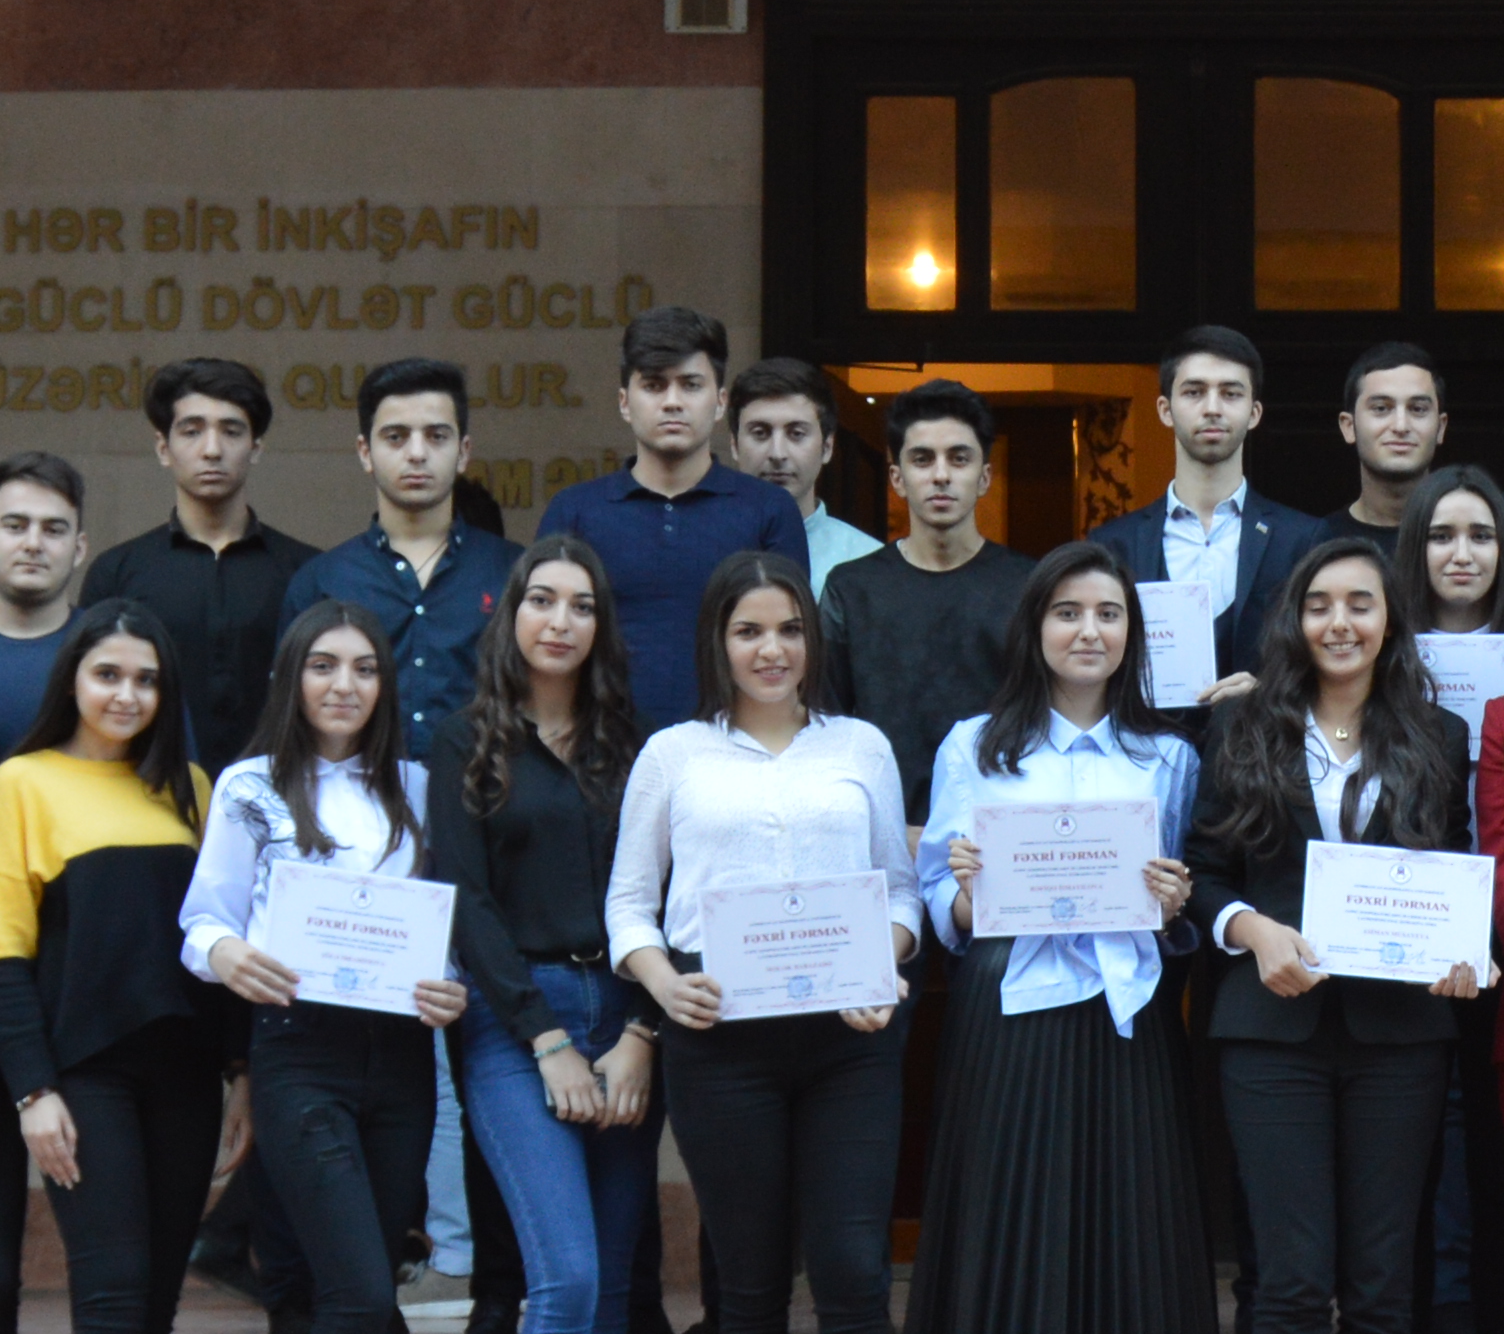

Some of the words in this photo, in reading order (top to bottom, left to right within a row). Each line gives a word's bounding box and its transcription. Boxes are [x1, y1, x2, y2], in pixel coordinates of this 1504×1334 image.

[3, 207, 125, 254] HƏR
[143, 197, 240, 253] BİR
[257, 197, 540, 262] İNKİŞAFIN
[201, 275, 436, 332] DÖVLƏT
[1013, 849, 1055, 863] FƏXRİ
[1059, 849, 1118, 861] FƏRMAN
[1346, 894, 1387, 908] FƏXRİ
[1392, 898, 1451, 913] FƏRMAN
[305, 916, 348, 931] FƏXRİ
[352, 922, 409, 940] FƏRMAN
[742, 928, 785, 945] FƏXRİ
[790, 925, 850, 941] FƏRMAN
